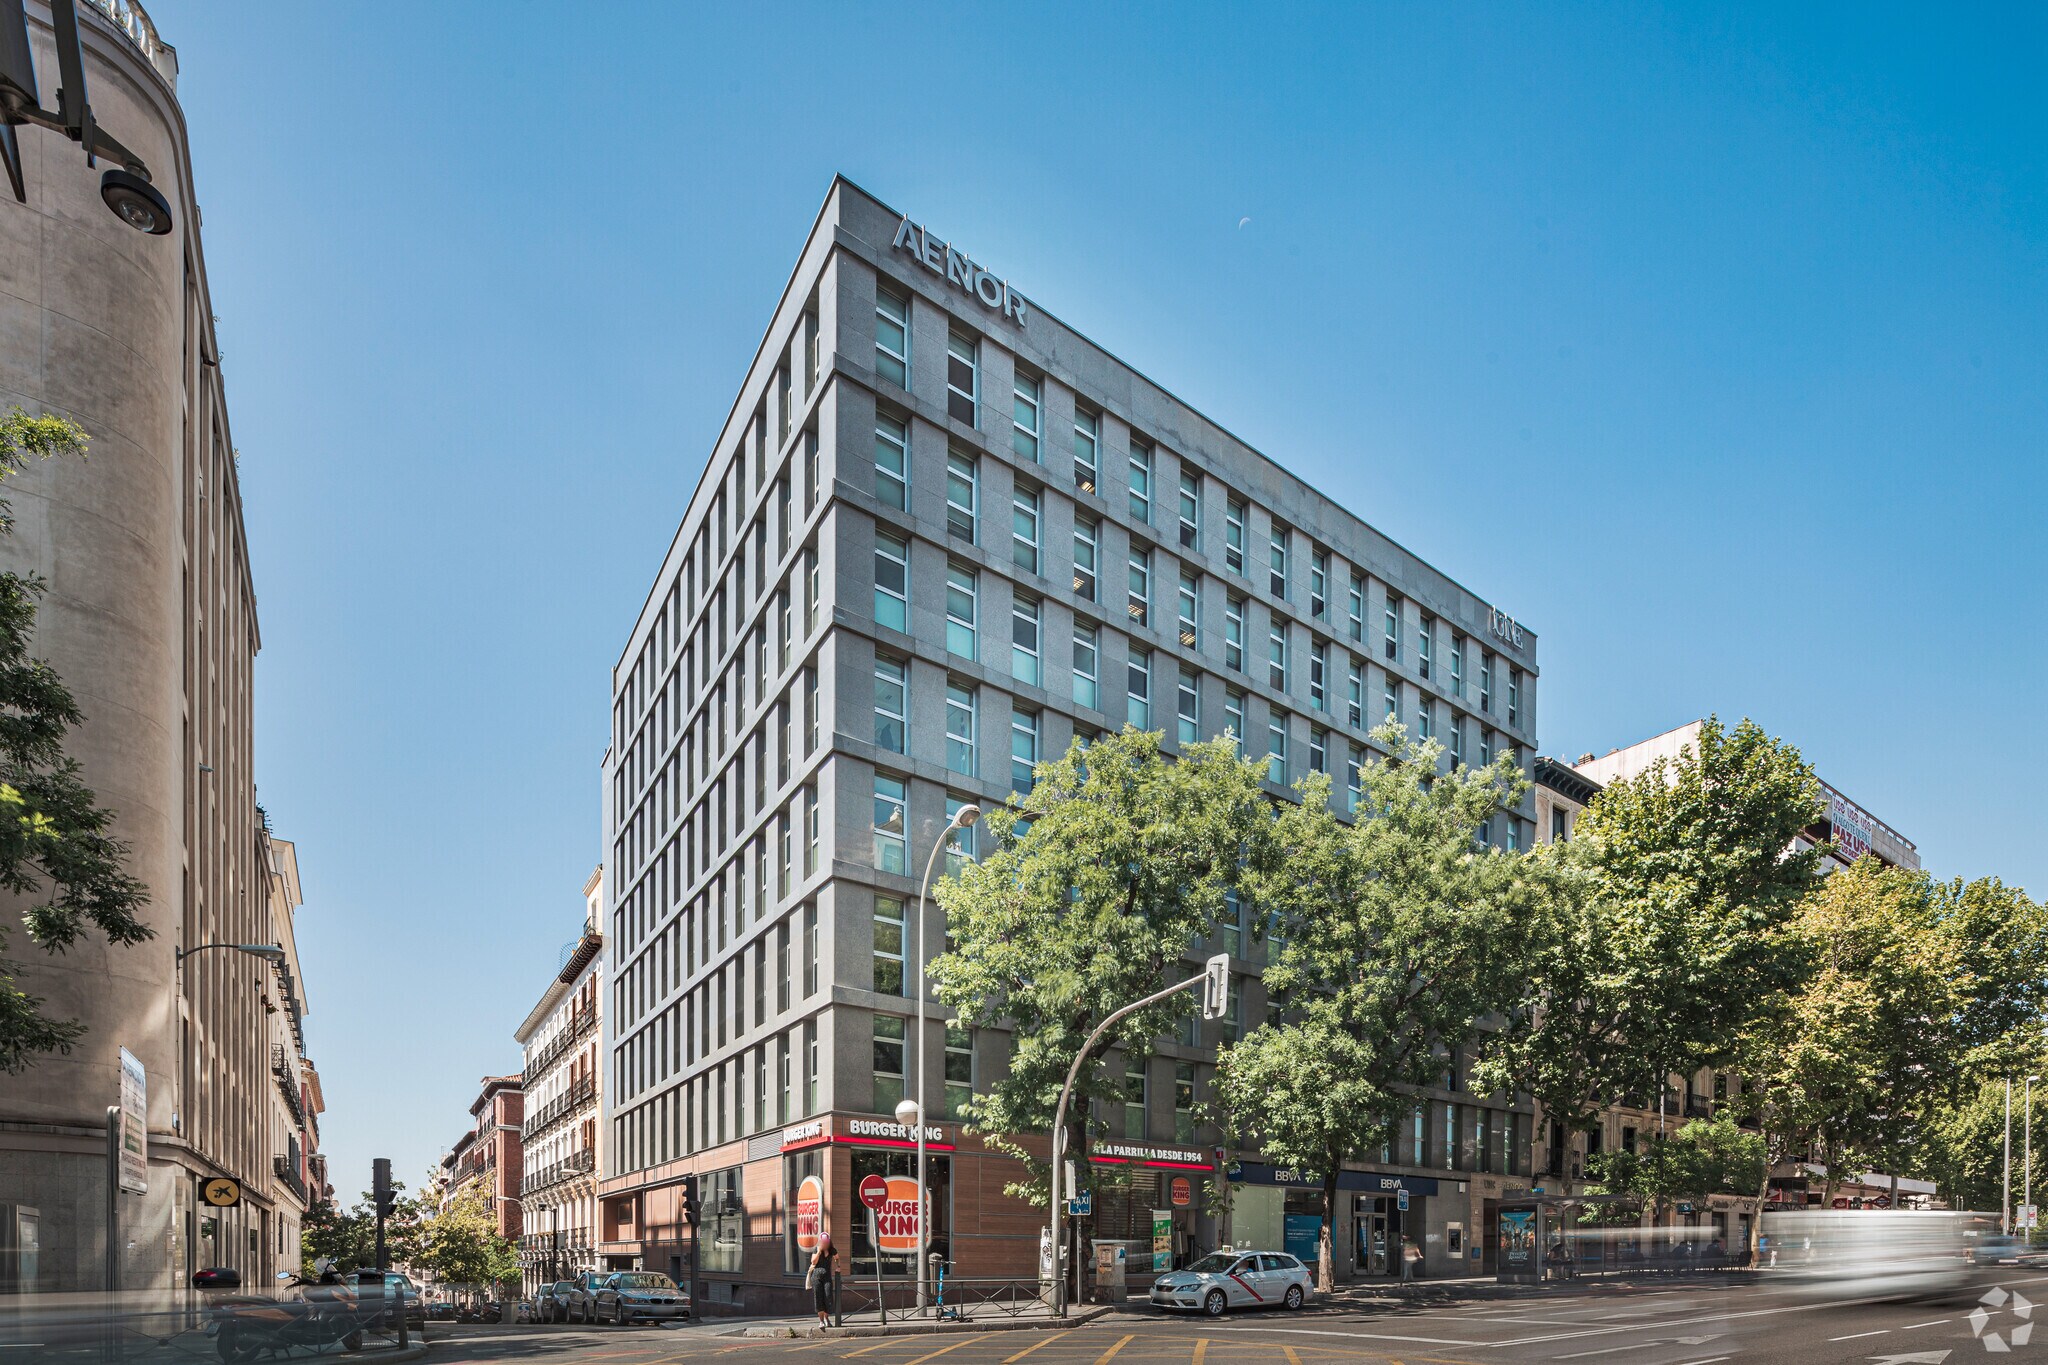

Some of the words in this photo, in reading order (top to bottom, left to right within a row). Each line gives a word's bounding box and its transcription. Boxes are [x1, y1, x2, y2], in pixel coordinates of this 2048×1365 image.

[892, 213, 1027, 328] AENOR
[850, 1120, 906, 1138] BURGER
[910, 1125, 943, 1141] KNG
[1101, 1145, 1113, 1155] LA
[1157, 1149, 1183, 1161] DESDE
[1183, 1151, 1202, 1162] 1954
[1380, 1178, 1402, 1189] BBVA
[1172, 1191, 1190, 1200] KING
[798, 1201, 819, 1216] BURGER
[797, 1215, 819, 1236] KING
